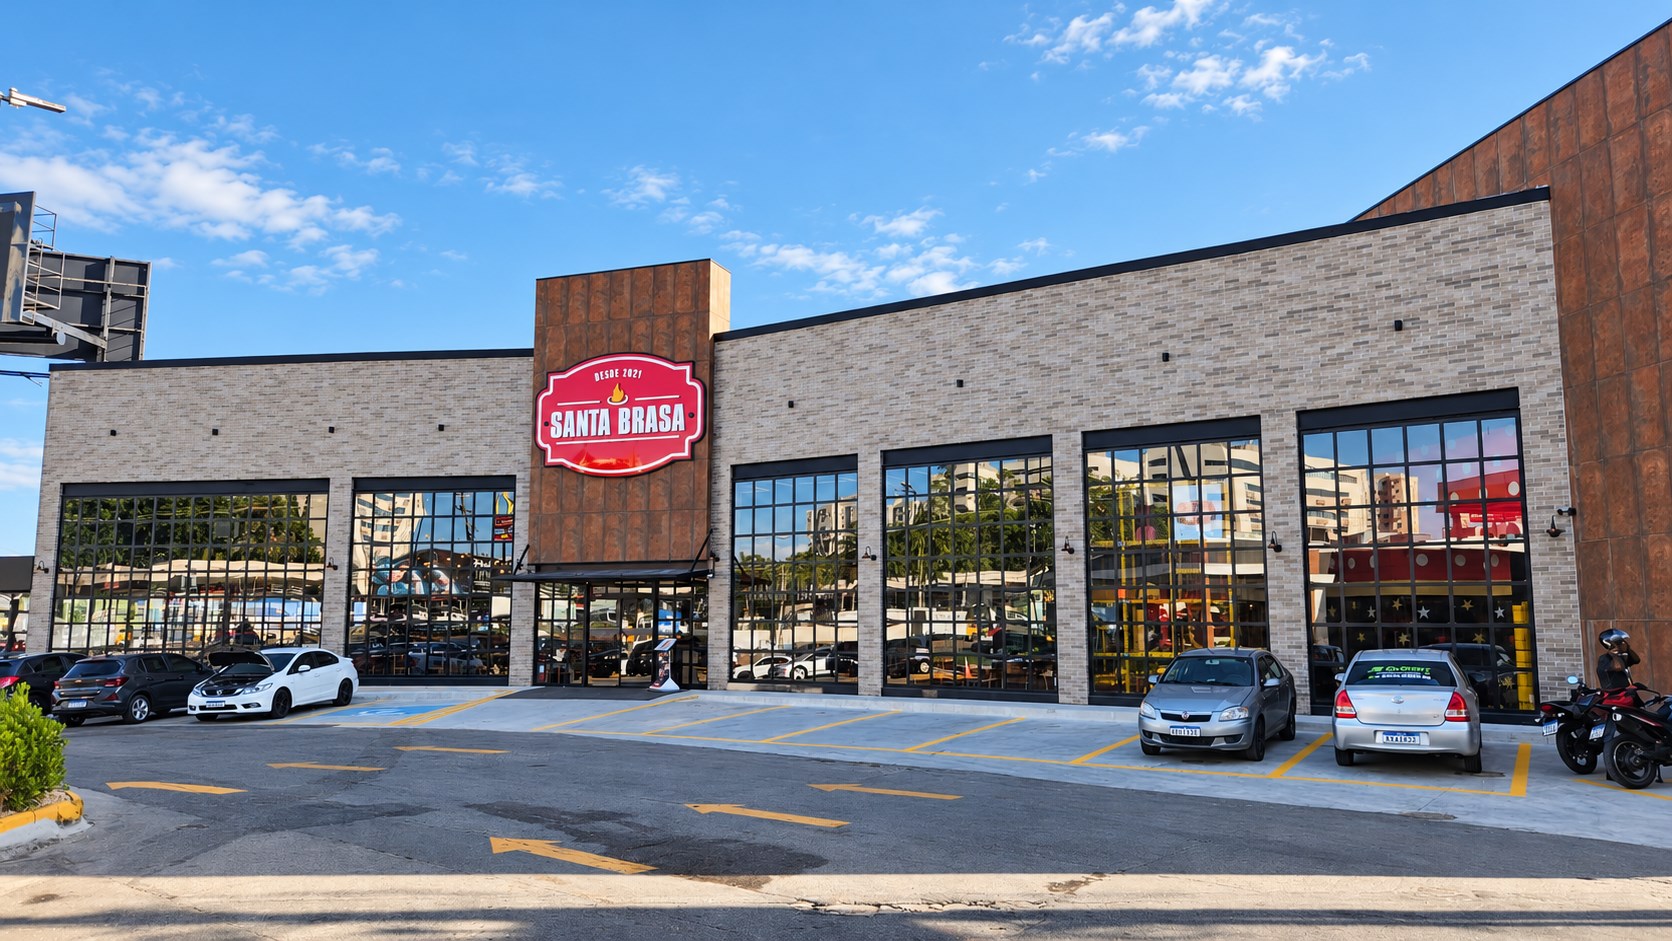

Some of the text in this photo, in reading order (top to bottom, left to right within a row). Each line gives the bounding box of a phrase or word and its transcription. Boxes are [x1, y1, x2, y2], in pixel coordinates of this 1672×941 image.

[594, 368, 643, 382] DESDE 2021
[550, 403, 686, 439] SANTA BRASA
